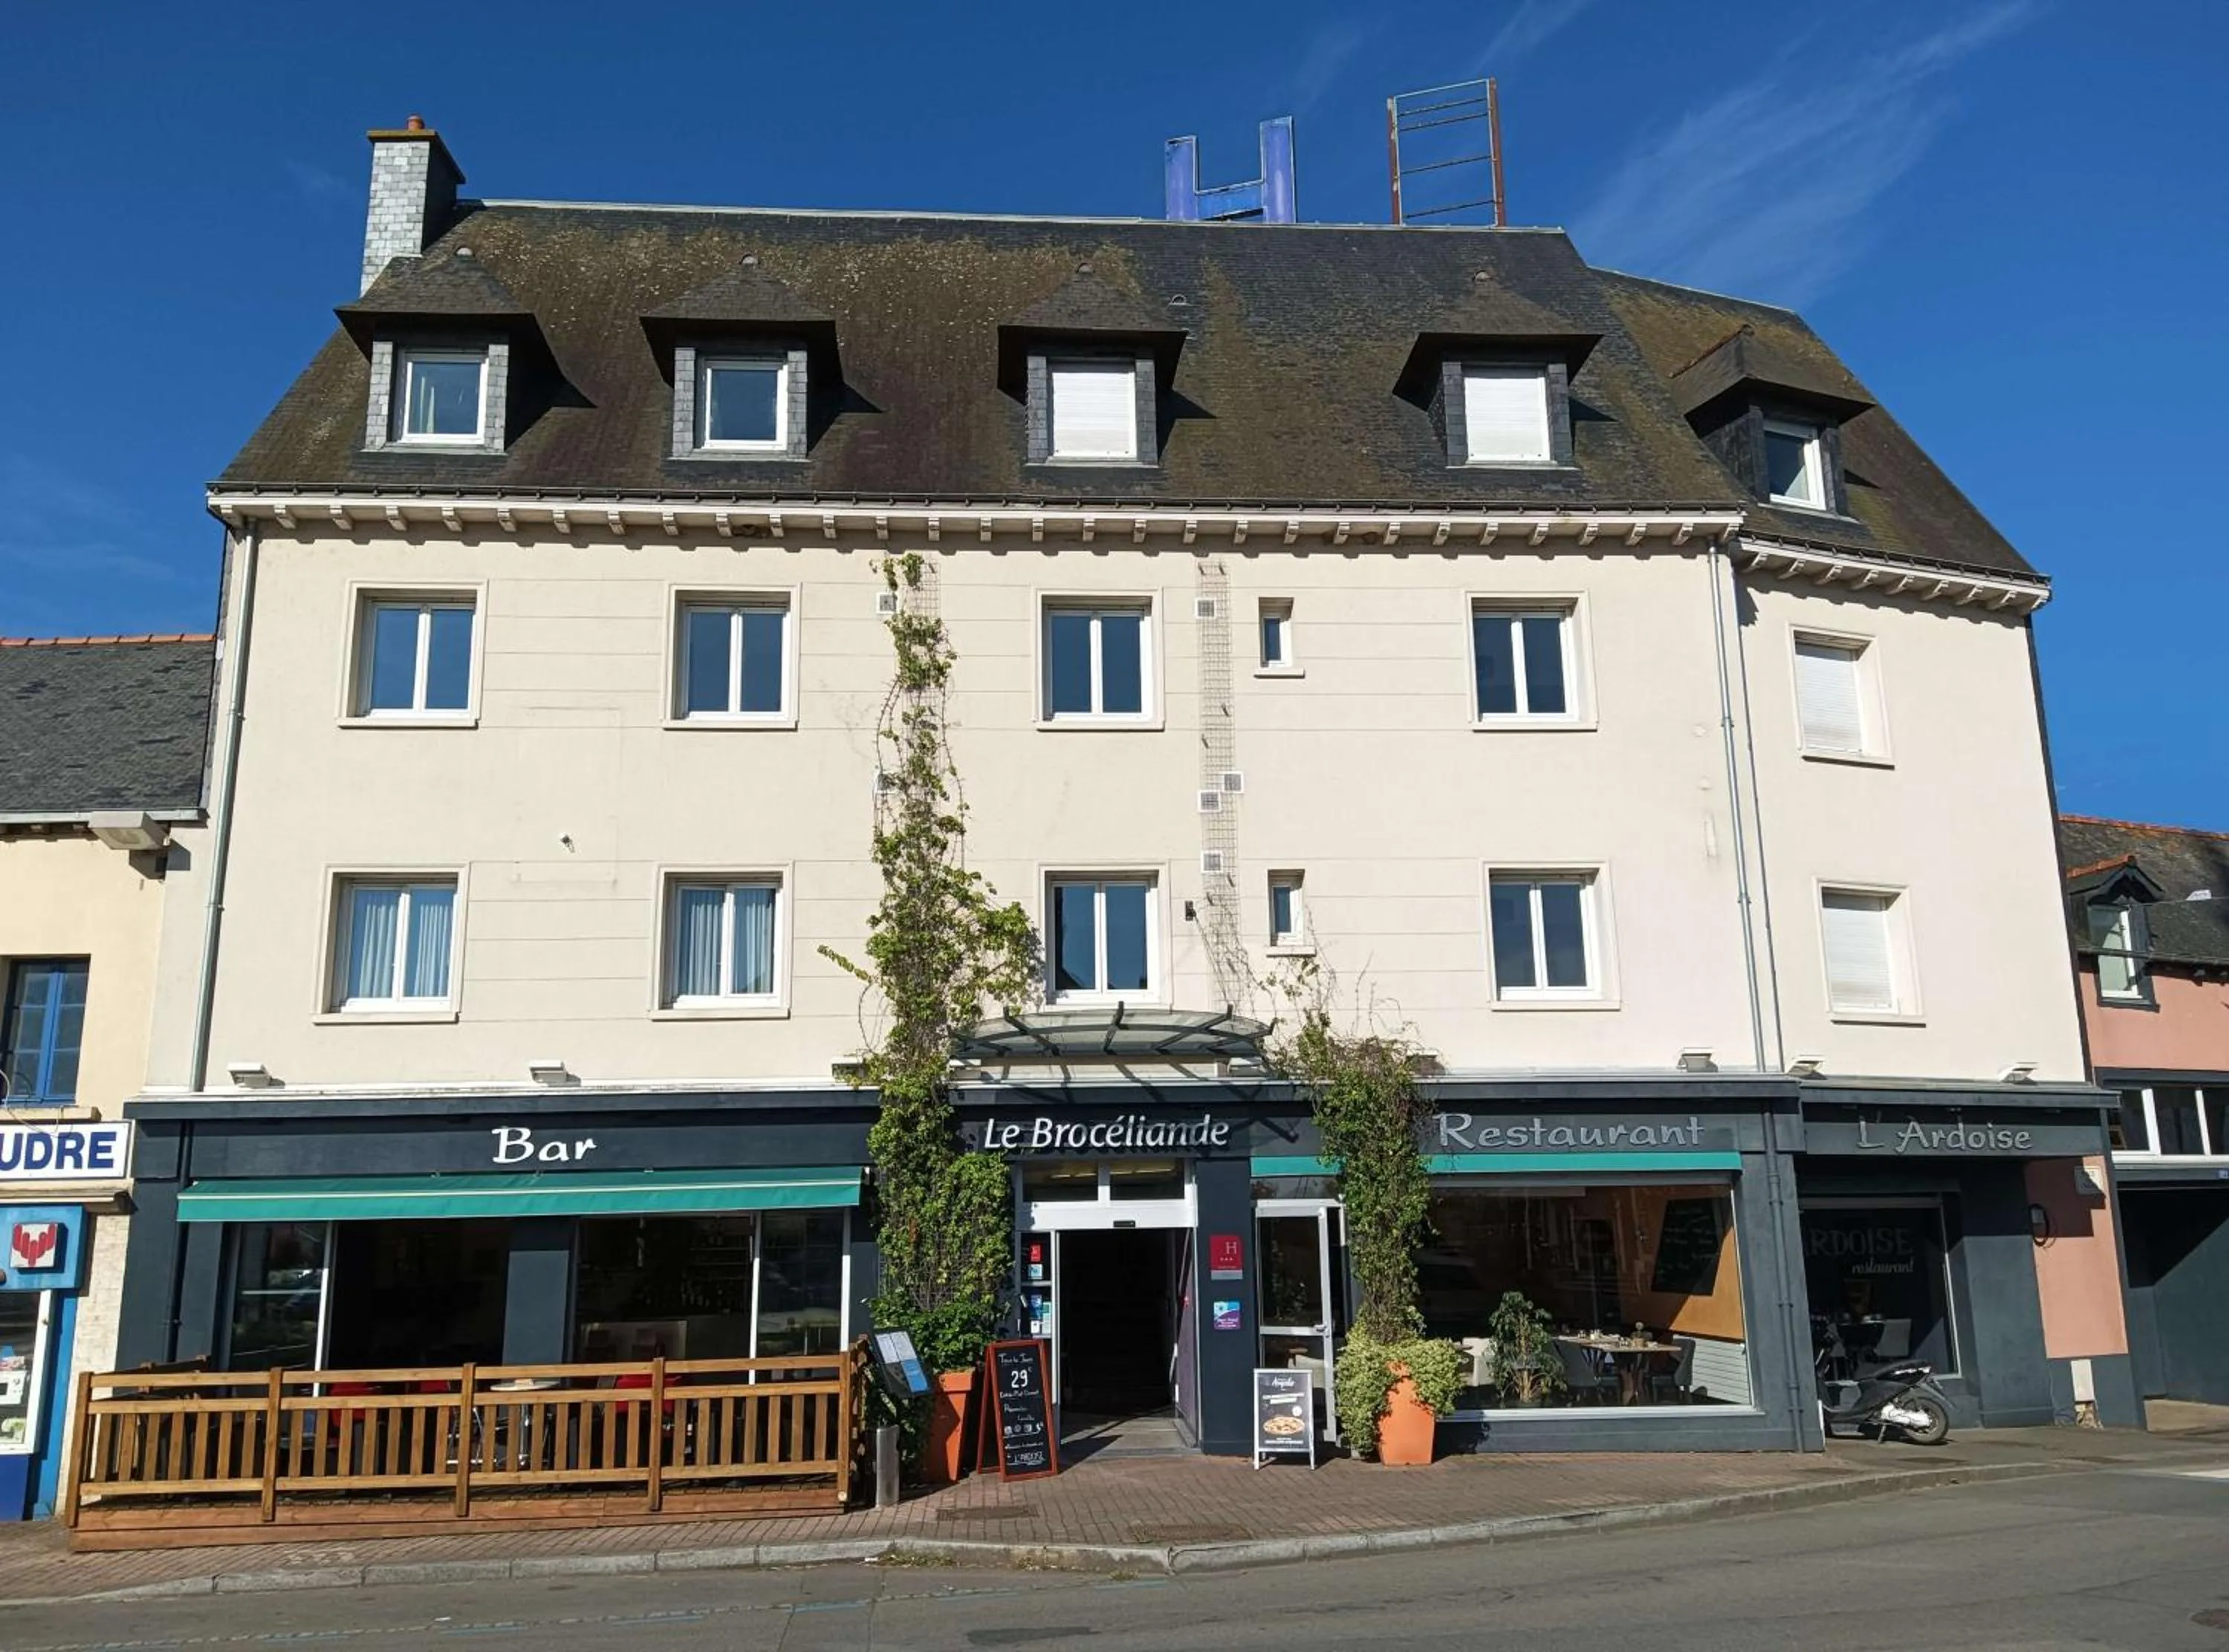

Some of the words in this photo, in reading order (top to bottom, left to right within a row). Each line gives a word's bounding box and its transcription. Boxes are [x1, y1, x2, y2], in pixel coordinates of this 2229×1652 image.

[491, 1126, 597, 1164] Bar
[984, 1117, 1020, 1149] Le
[1031, 1113, 1230, 1148] Brocéliande
[1433, 1112, 1705, 1149] Restaurant
[1224, 1241, 1237, 1255] H
[1851, 1255, 1915, 1275] restaurant
